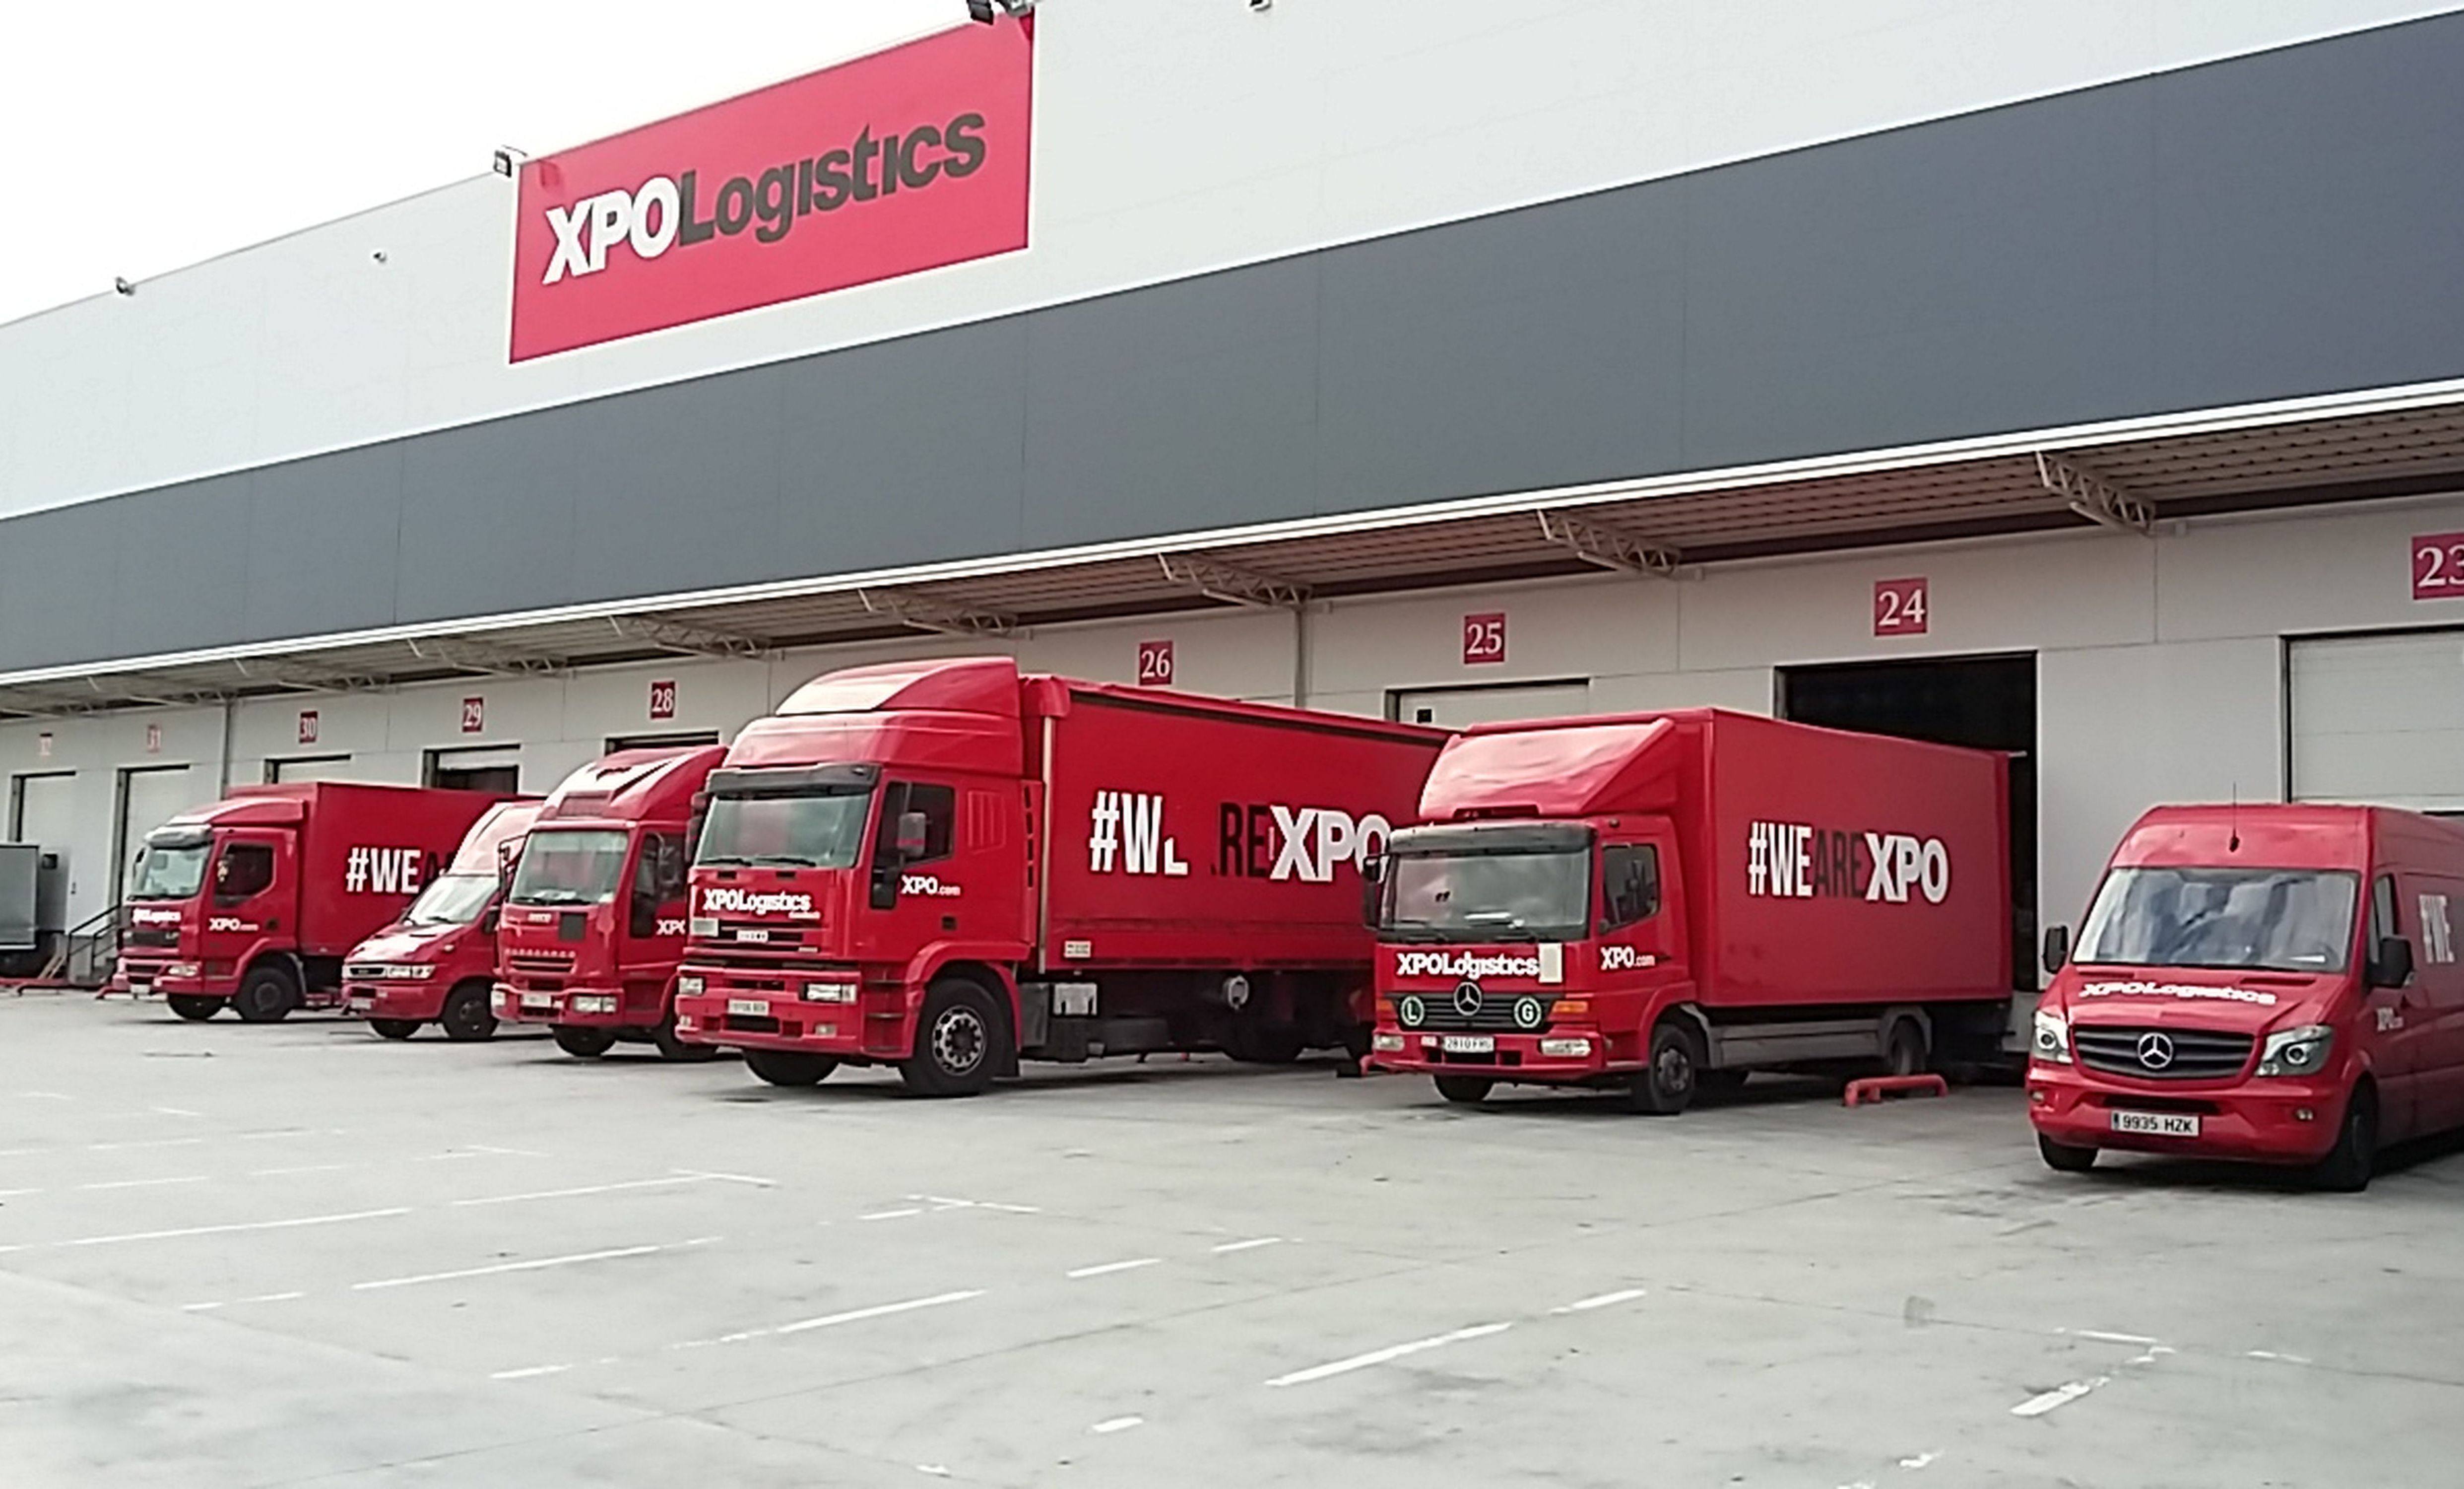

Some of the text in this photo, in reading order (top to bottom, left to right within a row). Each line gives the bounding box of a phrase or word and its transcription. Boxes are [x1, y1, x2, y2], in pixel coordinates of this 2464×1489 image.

[542, 114, 986, 285] XPOLogistics
[2416, 544, 2464, 588] 23
[1878, 589, 1925, 625] 24
[1467, 622, 1502, 655] 25
[1142, 649, 1170, 678] 26
[651, 688, 673, 712] 28
[300, 717, 317, 739] 30
[463, 703, 482, 728] 29
[1749, 821, 1949, 903] #WEAREXPO
[1396, 951, 1540, 980] XPOLogistics
[1407, 1003, 1417, 1020] L
[2123, 1115, 2193, 1133] 9935 HZK
